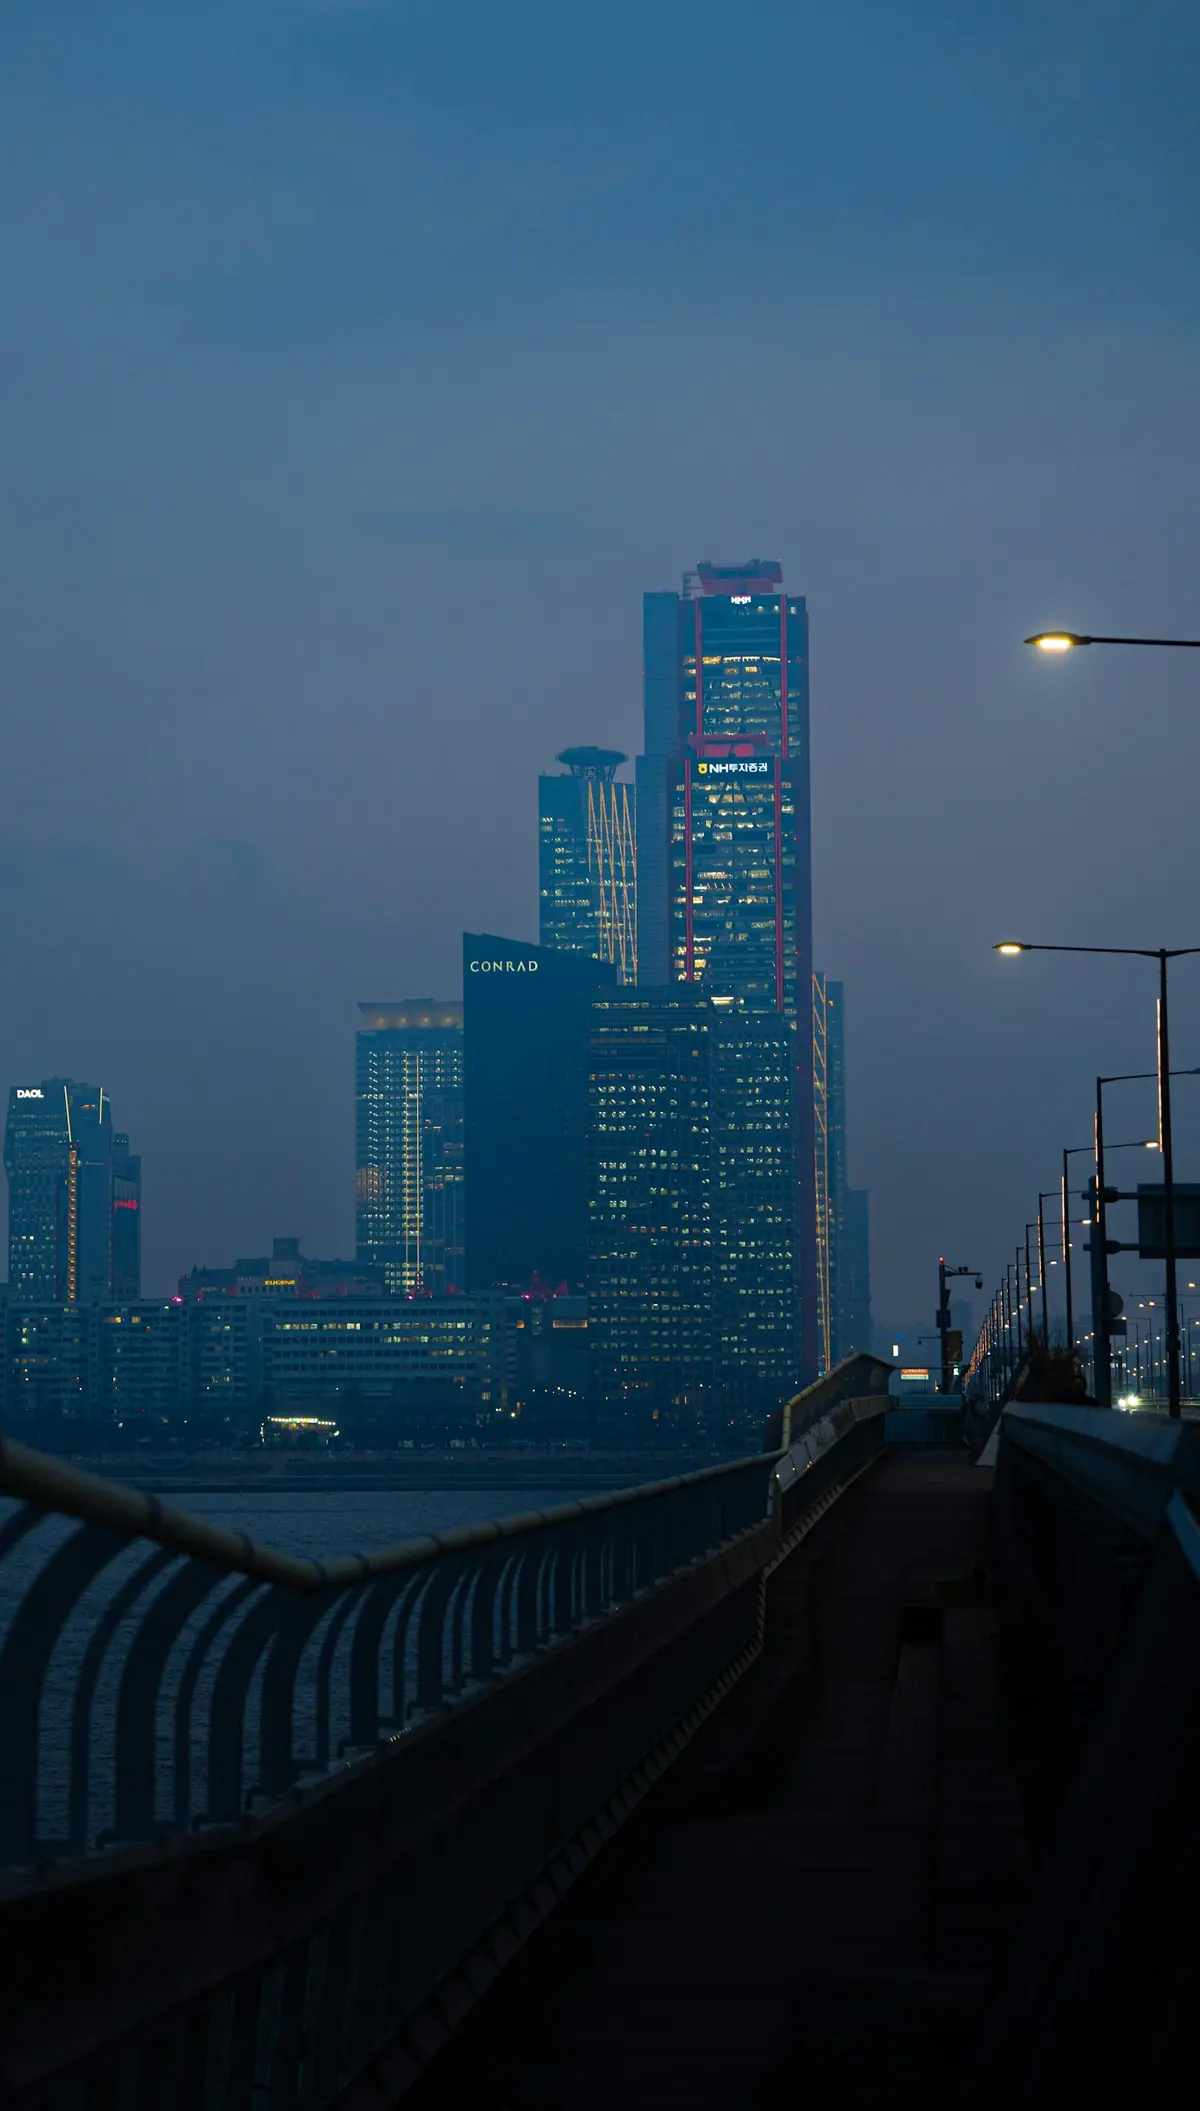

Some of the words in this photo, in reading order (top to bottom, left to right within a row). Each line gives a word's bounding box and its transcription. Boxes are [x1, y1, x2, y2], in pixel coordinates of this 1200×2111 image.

[709, 763, 768, 774] NH투자증권
[470, 961, 538, 972] CONRAD
[16, 1089, 44, 1098] DAOL
